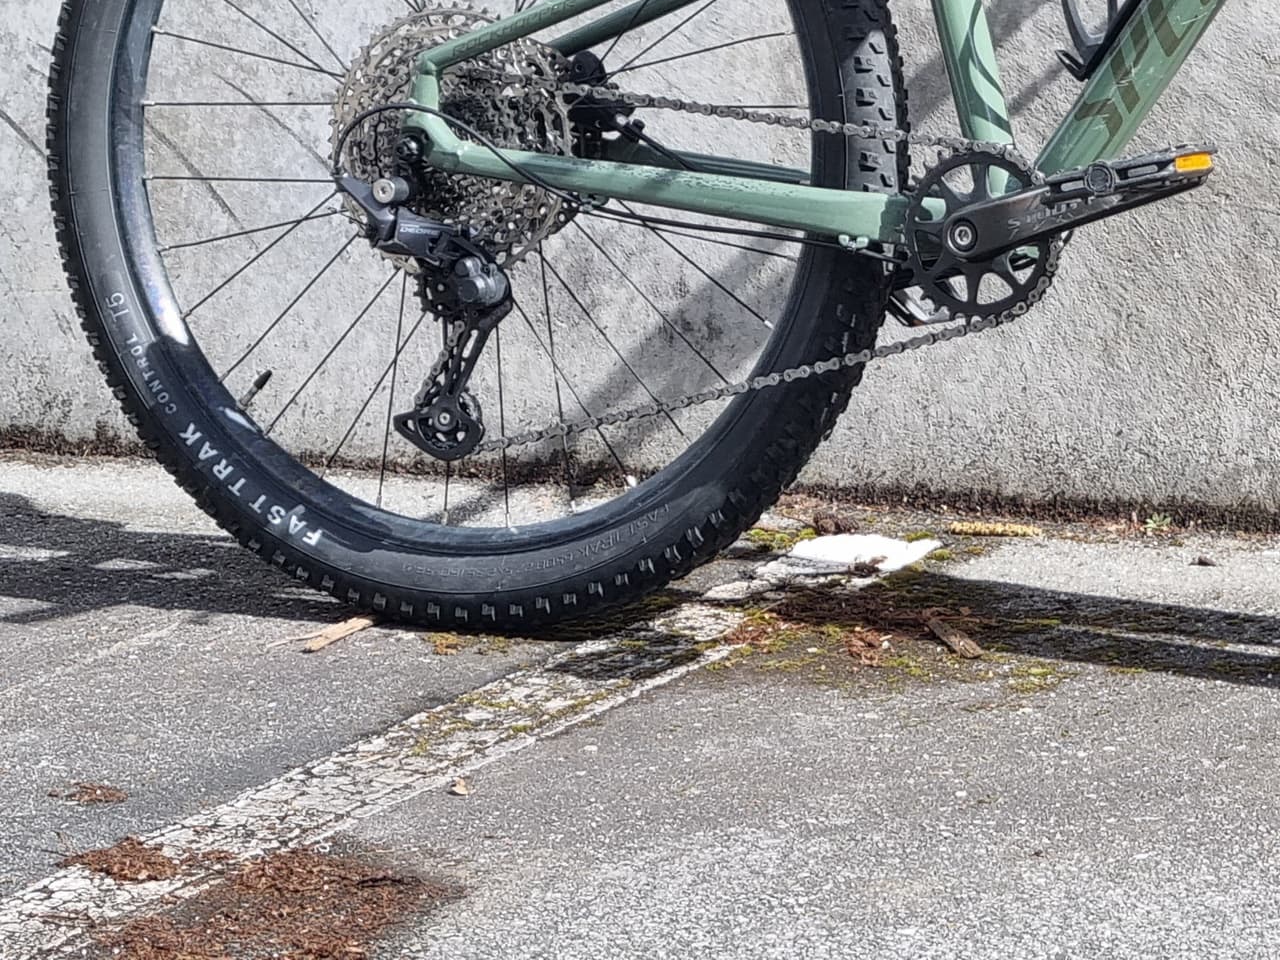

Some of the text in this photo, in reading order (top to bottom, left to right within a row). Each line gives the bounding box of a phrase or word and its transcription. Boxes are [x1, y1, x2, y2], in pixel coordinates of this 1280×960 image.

[399, 226, 439, 236] DEORE
[105, 292, 322, 546] FAST TRAK CONTROL T5
